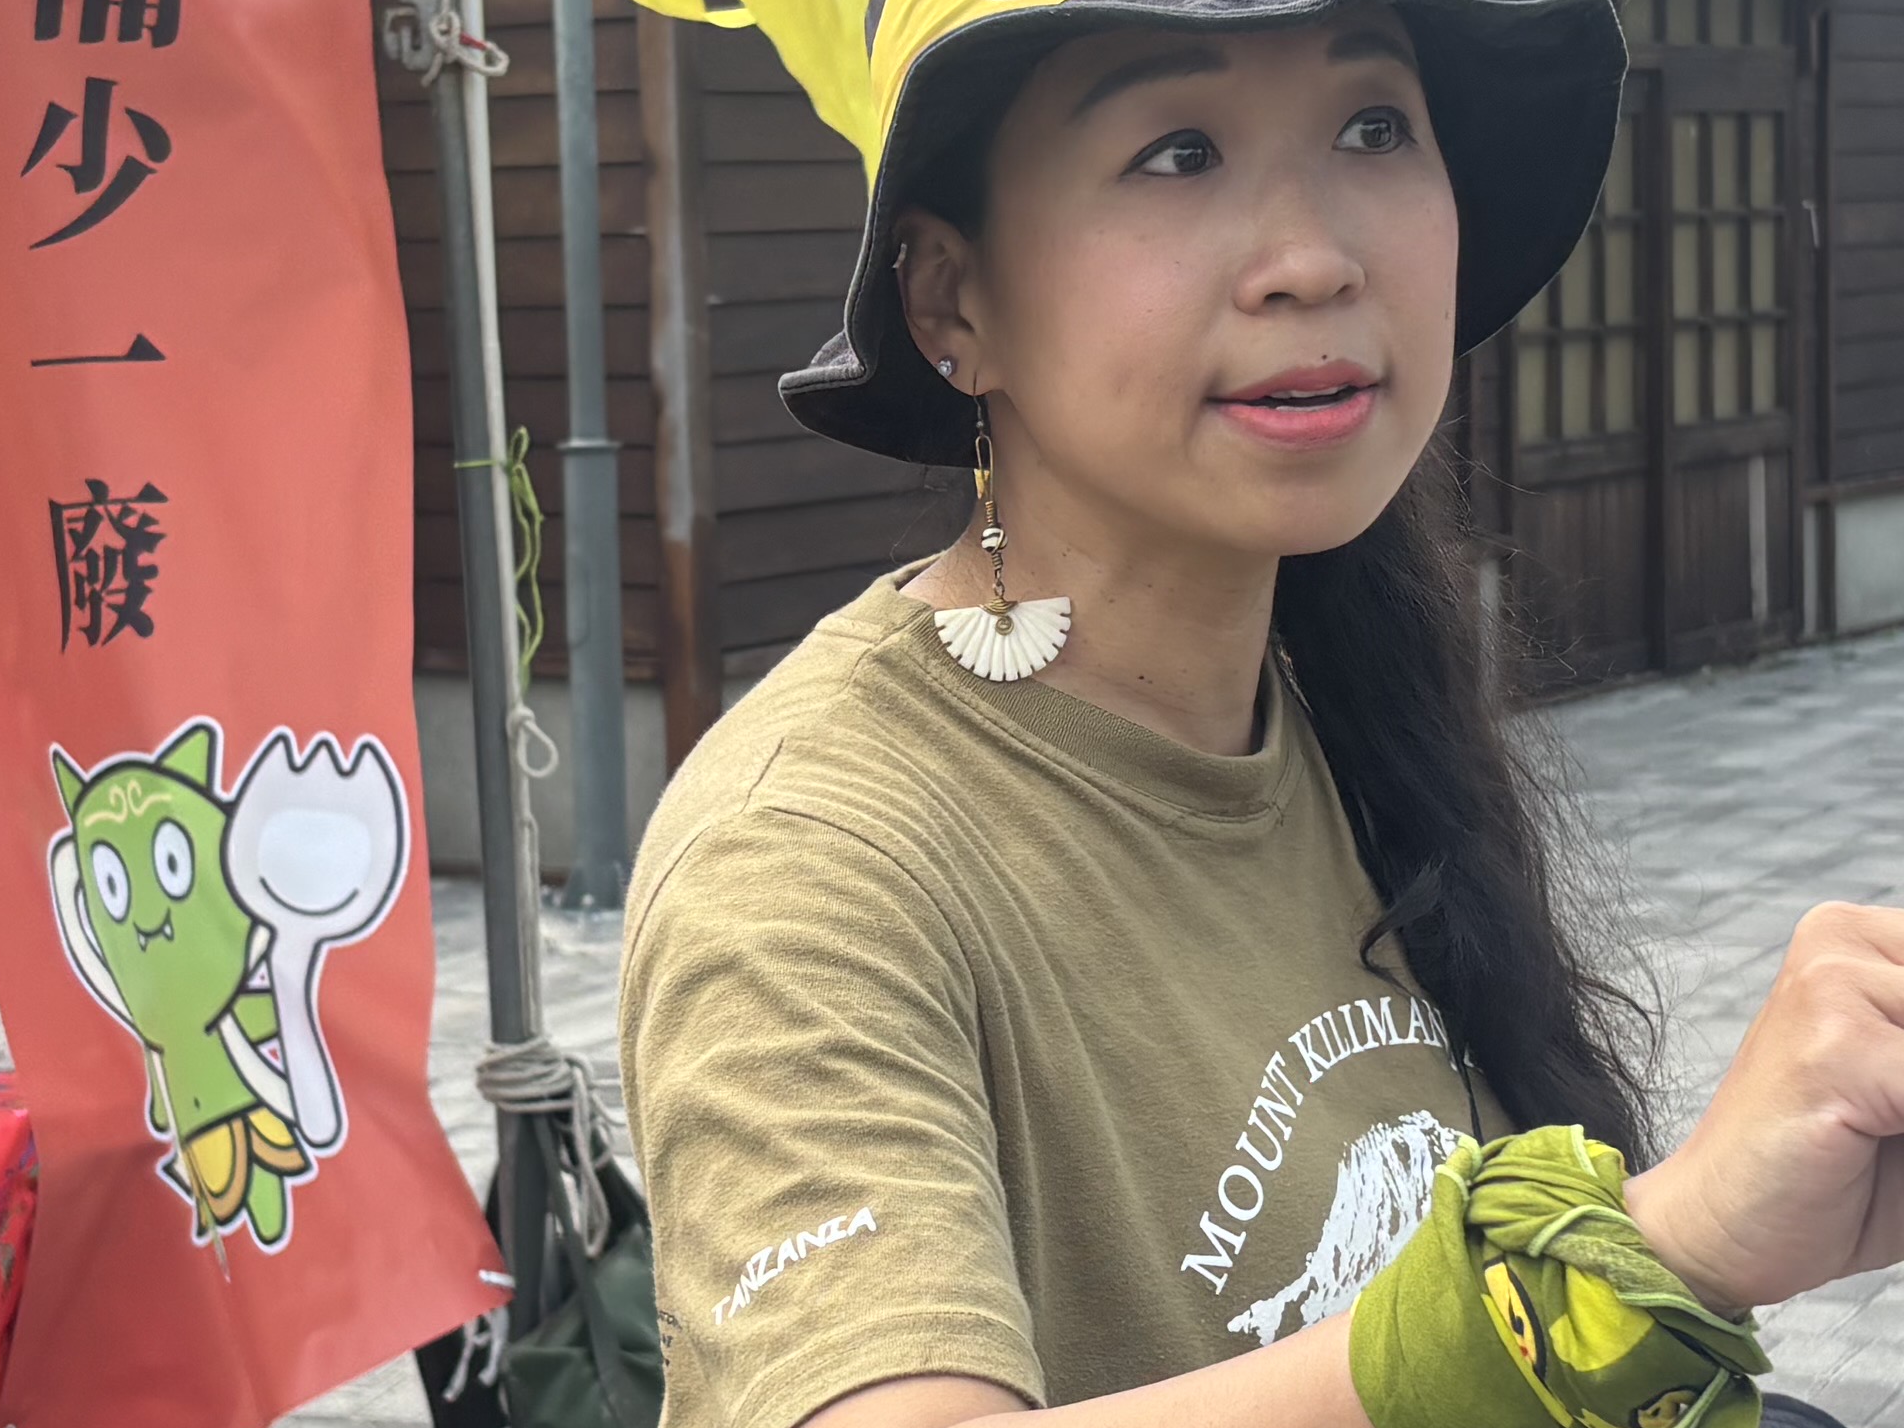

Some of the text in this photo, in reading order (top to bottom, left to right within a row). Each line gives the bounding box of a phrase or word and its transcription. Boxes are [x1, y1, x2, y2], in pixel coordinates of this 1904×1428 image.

[1180, 996, 1457, 1295] MOUNT KILIMAN
[711, 1207, 877, 1325] TANZANIA
